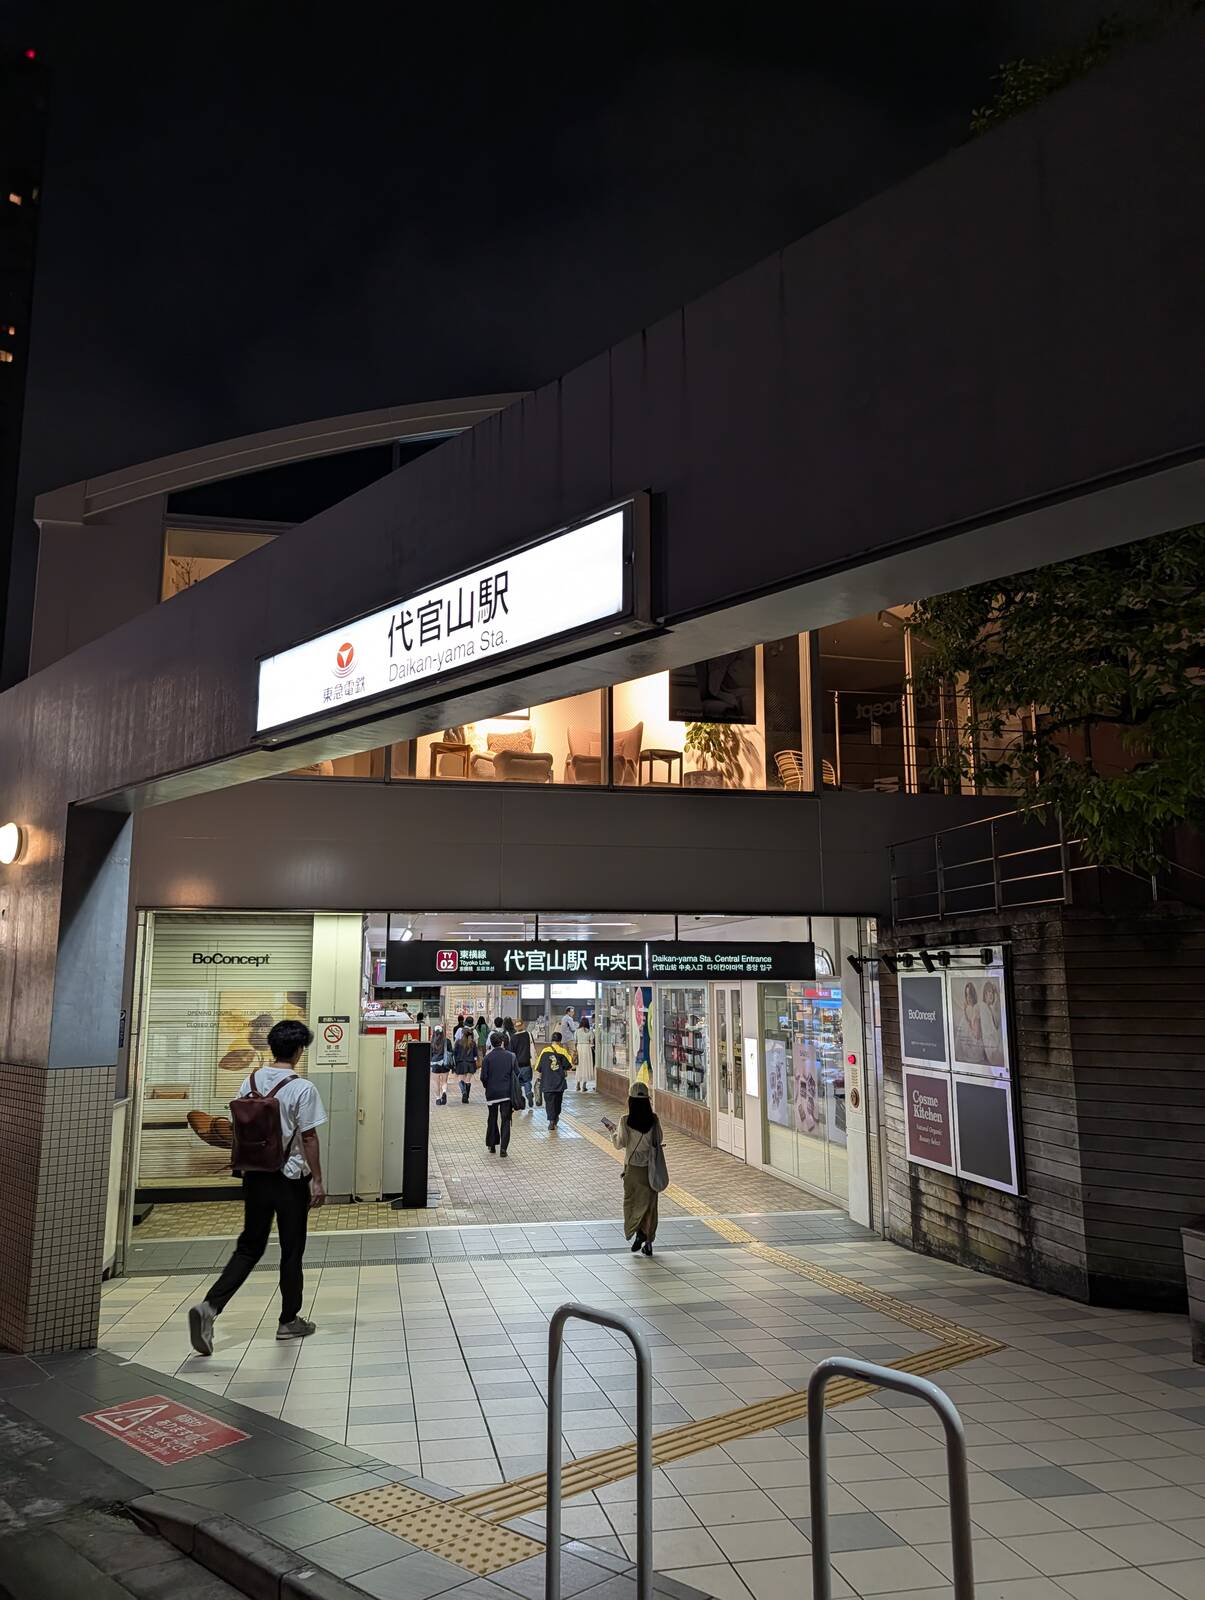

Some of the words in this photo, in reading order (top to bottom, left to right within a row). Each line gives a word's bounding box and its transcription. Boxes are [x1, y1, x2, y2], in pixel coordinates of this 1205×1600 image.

[387, 570, 510, 659] 代官山駅
[388, 640, 475, 684] Daikan-yama
[479, 629, 508, 653] Sta.
[322, 675, 367, 705] 東急電鉄
[192, 953, 270, 967] BoConcept
[459, 950, 487, 960] 東横線
[503, 949, 588, 972] 代官山駅
[593, 953, 643, 972] 中央口
[652, 954, 698, 965] Daikan-yama
[699, 954, 713, 963] Sta.
[715, 954, 740, 963] Central
[741, 954, 772, 963] Entrance
[440, 960, 454, 969] 02
[908, 1009, 937, 1023] BoConcept
[912, 1089, 939, 1107] Cosme
[912, 1104, 943, 1124] Kitchen
